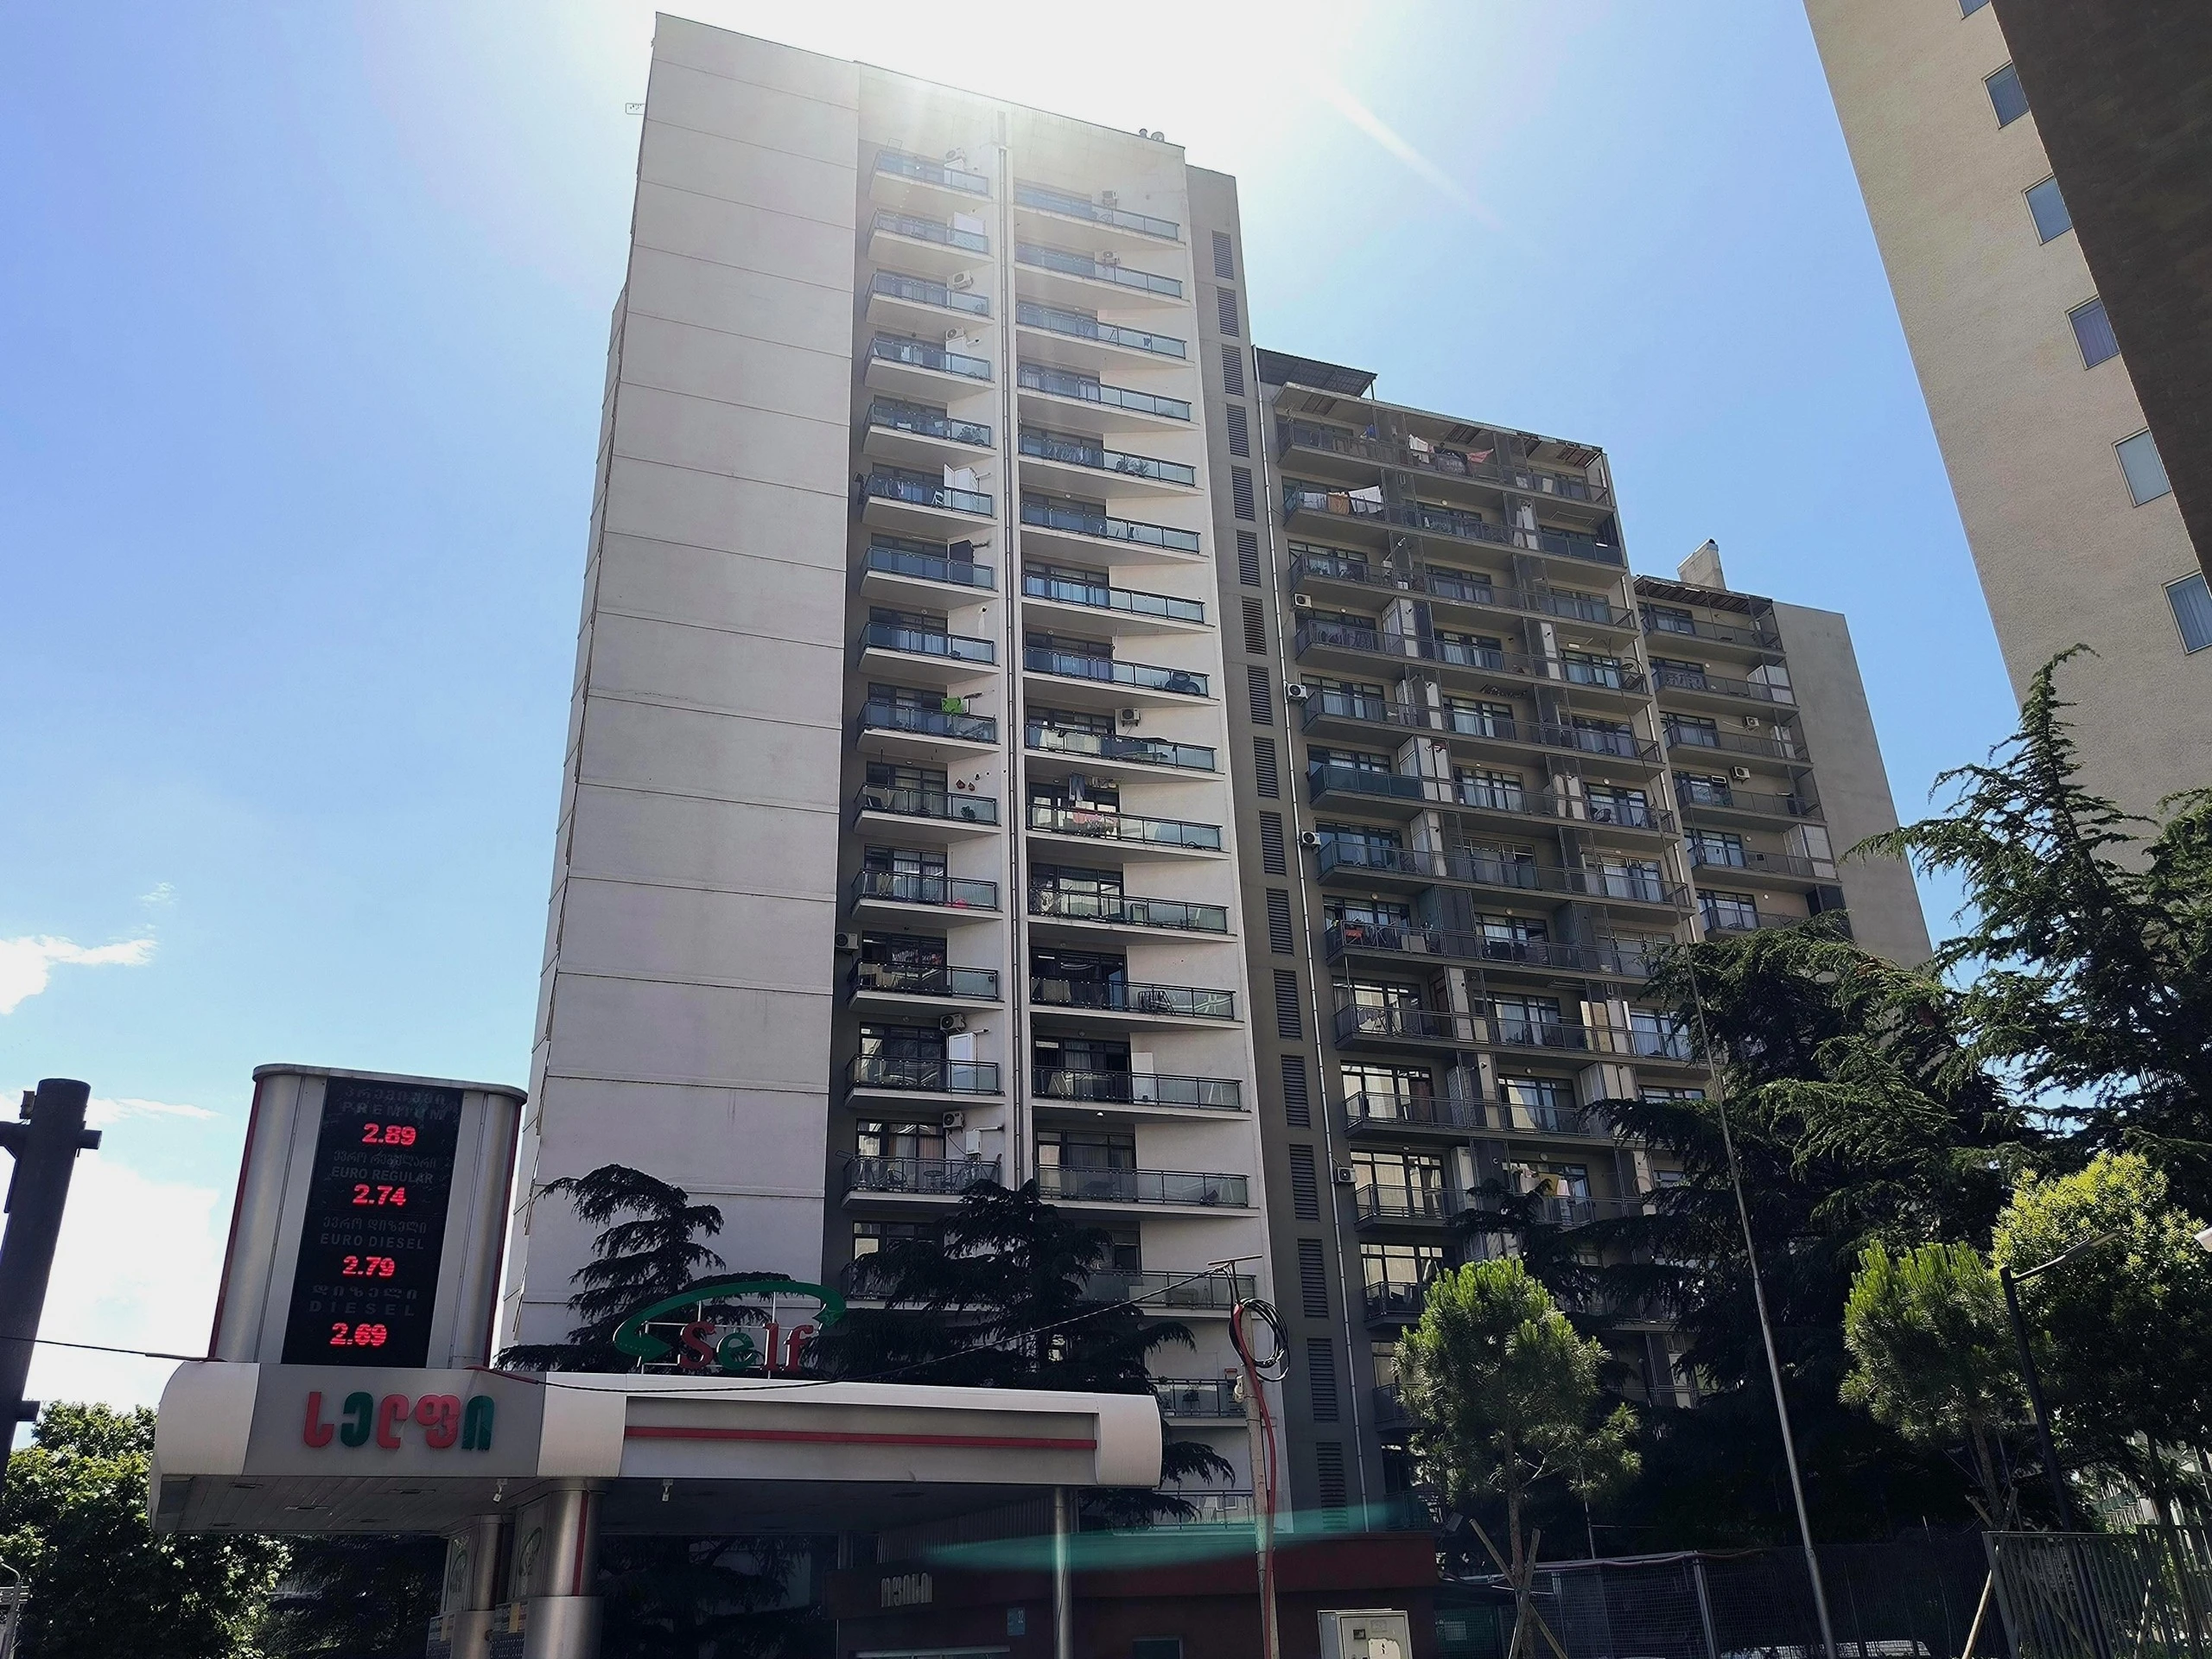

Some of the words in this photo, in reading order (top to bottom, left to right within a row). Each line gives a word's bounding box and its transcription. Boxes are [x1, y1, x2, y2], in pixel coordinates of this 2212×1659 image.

[361, 1122, 416, 1147] 2.89
[332, 1166, 367, 1179] EURO
[372, 1169, 434, 1184] REGULAR
[353, 1185, 406, 1206] 2.74
[323, 1216, 362, 1229] ევრო
[367, 1217, 427, 1234] დიზელი
[321, 1233, 362, 1246] EURO
[369, 1236, 424, 1249] DIESEL
[342, 1255, 396, 1277] 2.79
[311, 1284, 417, 1300] დიზელი
[309, 1300, 415, 1317] DIESEL
[330, 1323, 387, 1346] 2.69
[677, 1320, 813, 1372] Self
[303, 1391, 494, 1450] სელფი
